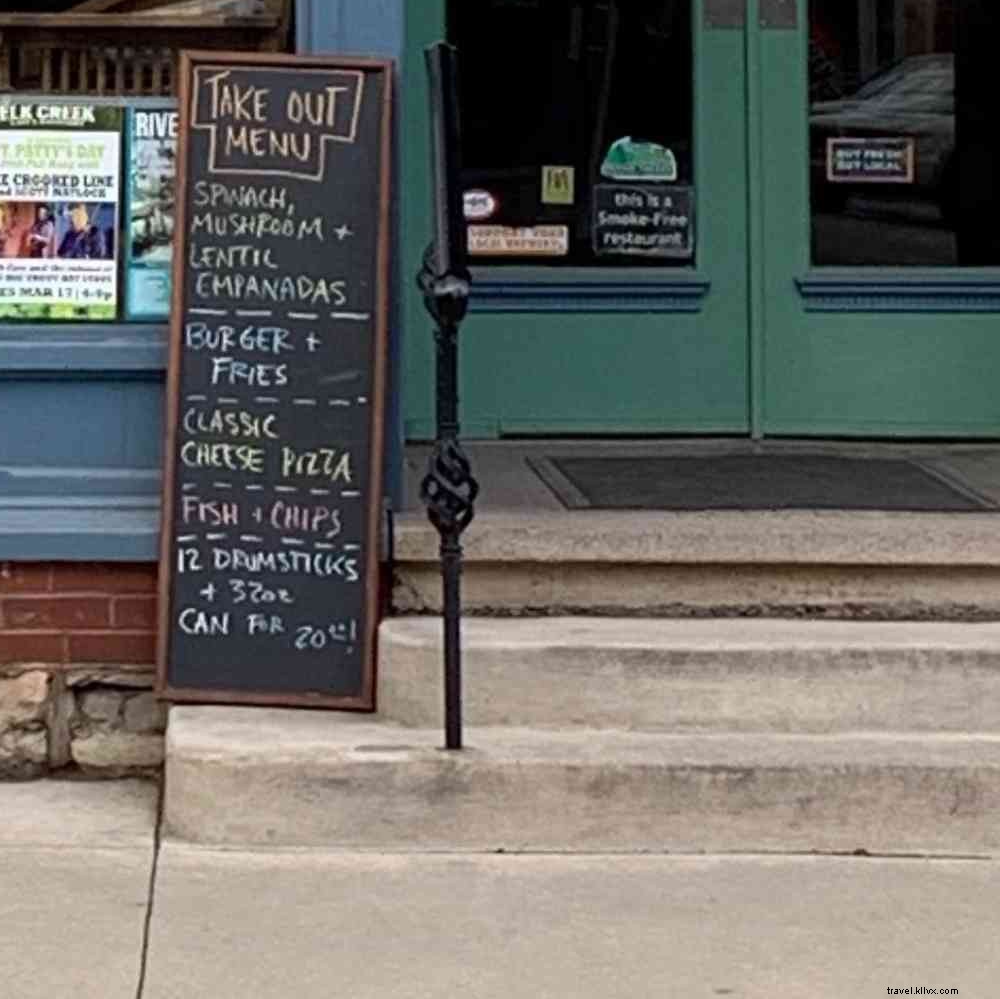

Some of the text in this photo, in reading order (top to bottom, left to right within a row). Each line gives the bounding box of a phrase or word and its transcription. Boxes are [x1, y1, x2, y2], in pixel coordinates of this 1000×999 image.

[205, 70, 349, 126] TAKE OUT
[35, 105, 96, 123] CREEK
[224, 126, 312, 161] MENU
[614, 193, 672, 207] this is a
[190, 214, 324, 241] MUSHROOM
[19, 287, 52, 297] MAR
[57, 287, 72, 297] 17
[196, 273, 347, 305] EMPANADAS
[185, 324, 294, 353] BURGER
[210, 357, 288, 387] FRIES
[184, 408, 279, 440] CLASSIC
[181, 441, 351, 483] CHEESE PIZZA
[182, 496, 239, 526] FISH
[270, 501, 342, 538] CHIPS
[177, 548, 360, 582] 12 DRUMSTICKS
[178, 607, 230, 636] CAN
